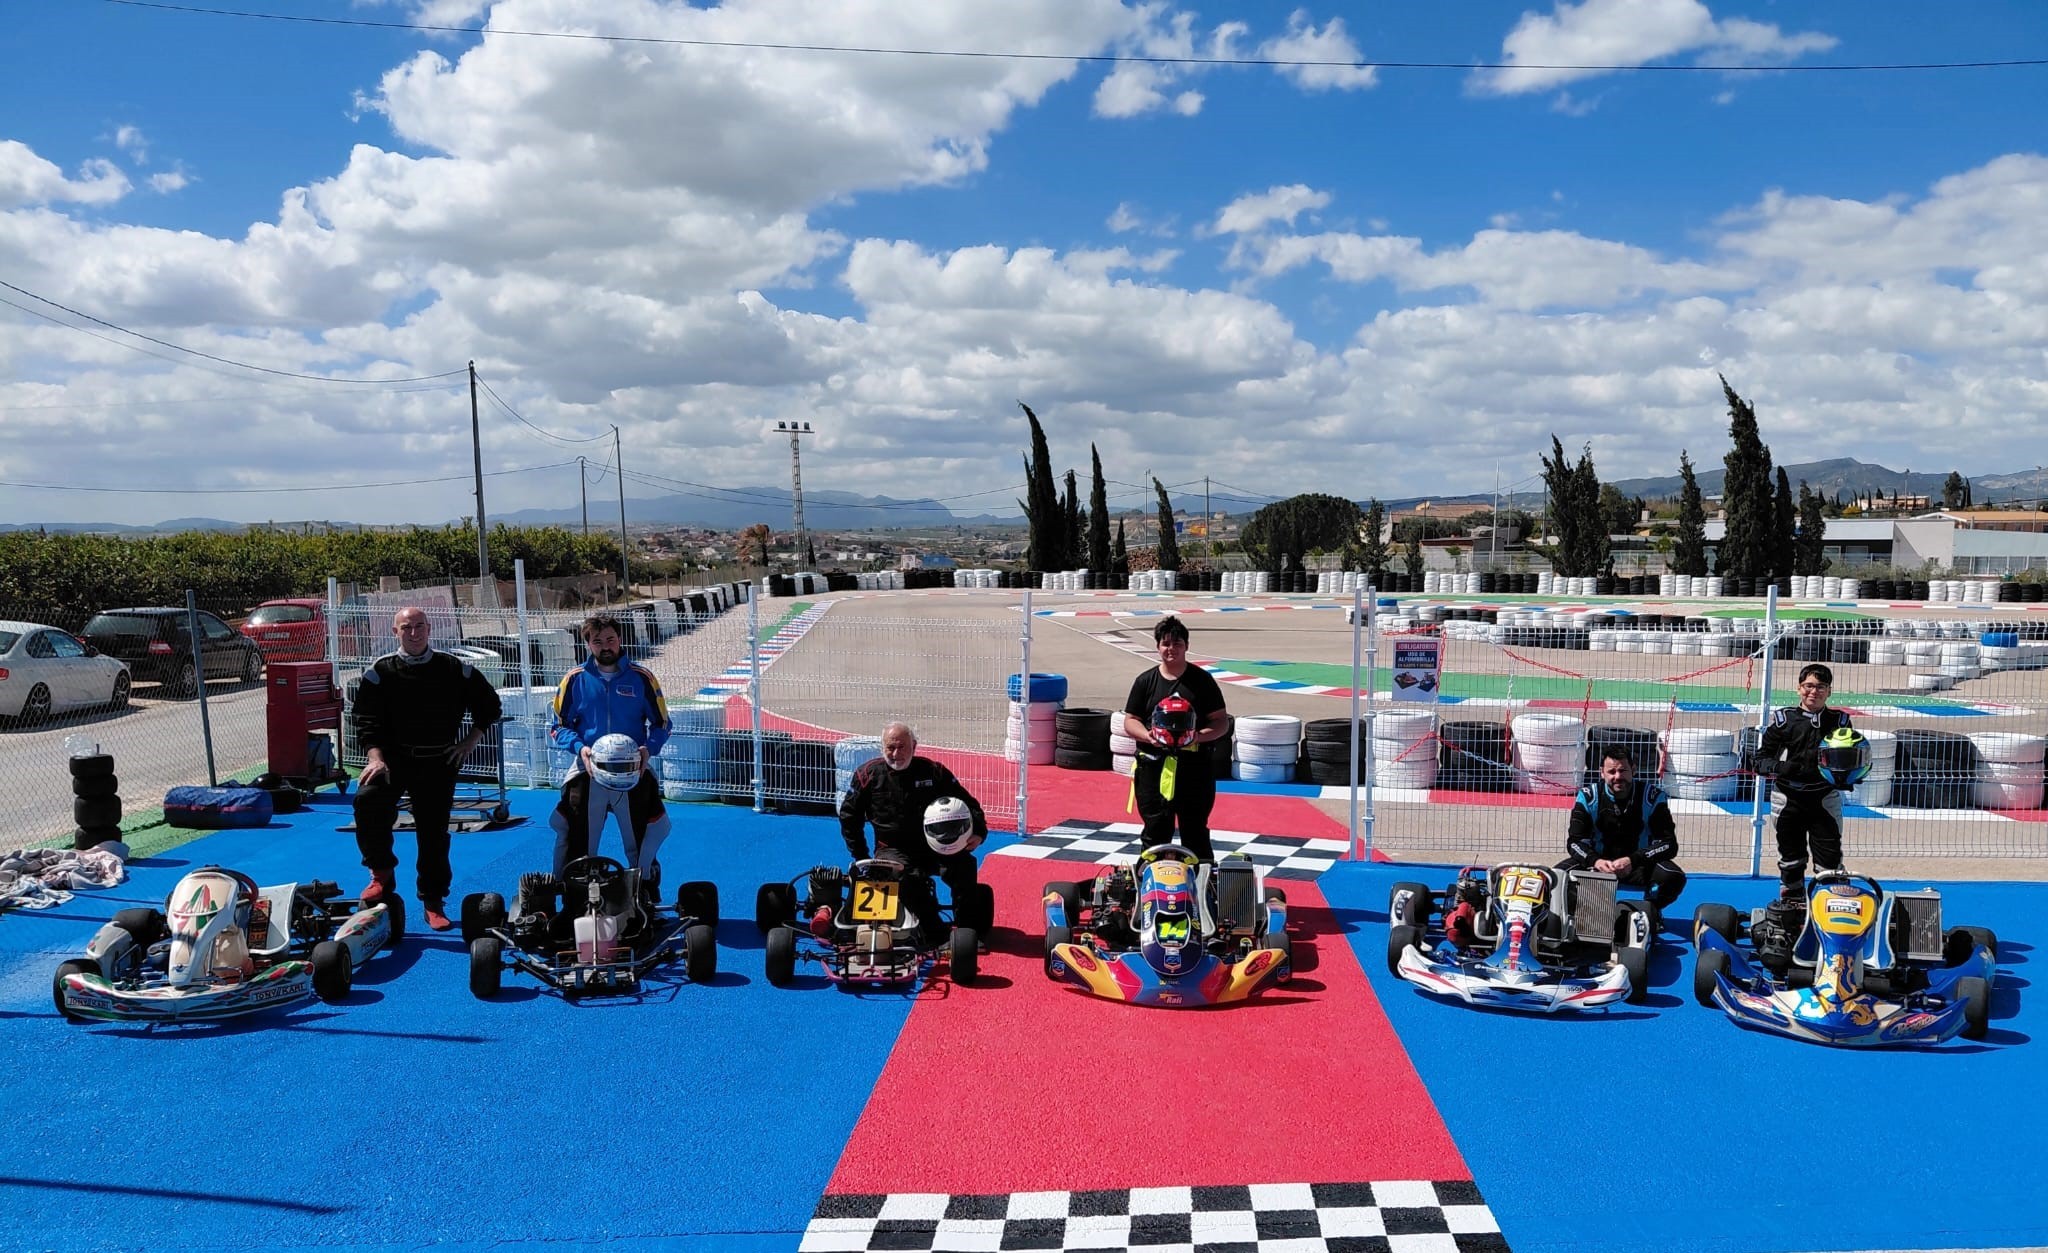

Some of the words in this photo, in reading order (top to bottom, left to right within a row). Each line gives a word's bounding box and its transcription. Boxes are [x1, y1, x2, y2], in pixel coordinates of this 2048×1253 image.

[858, 885, 890, 912] 21
[1504, 875, 1543, 899] 19
[1159, 919, 1188, 938] 14
